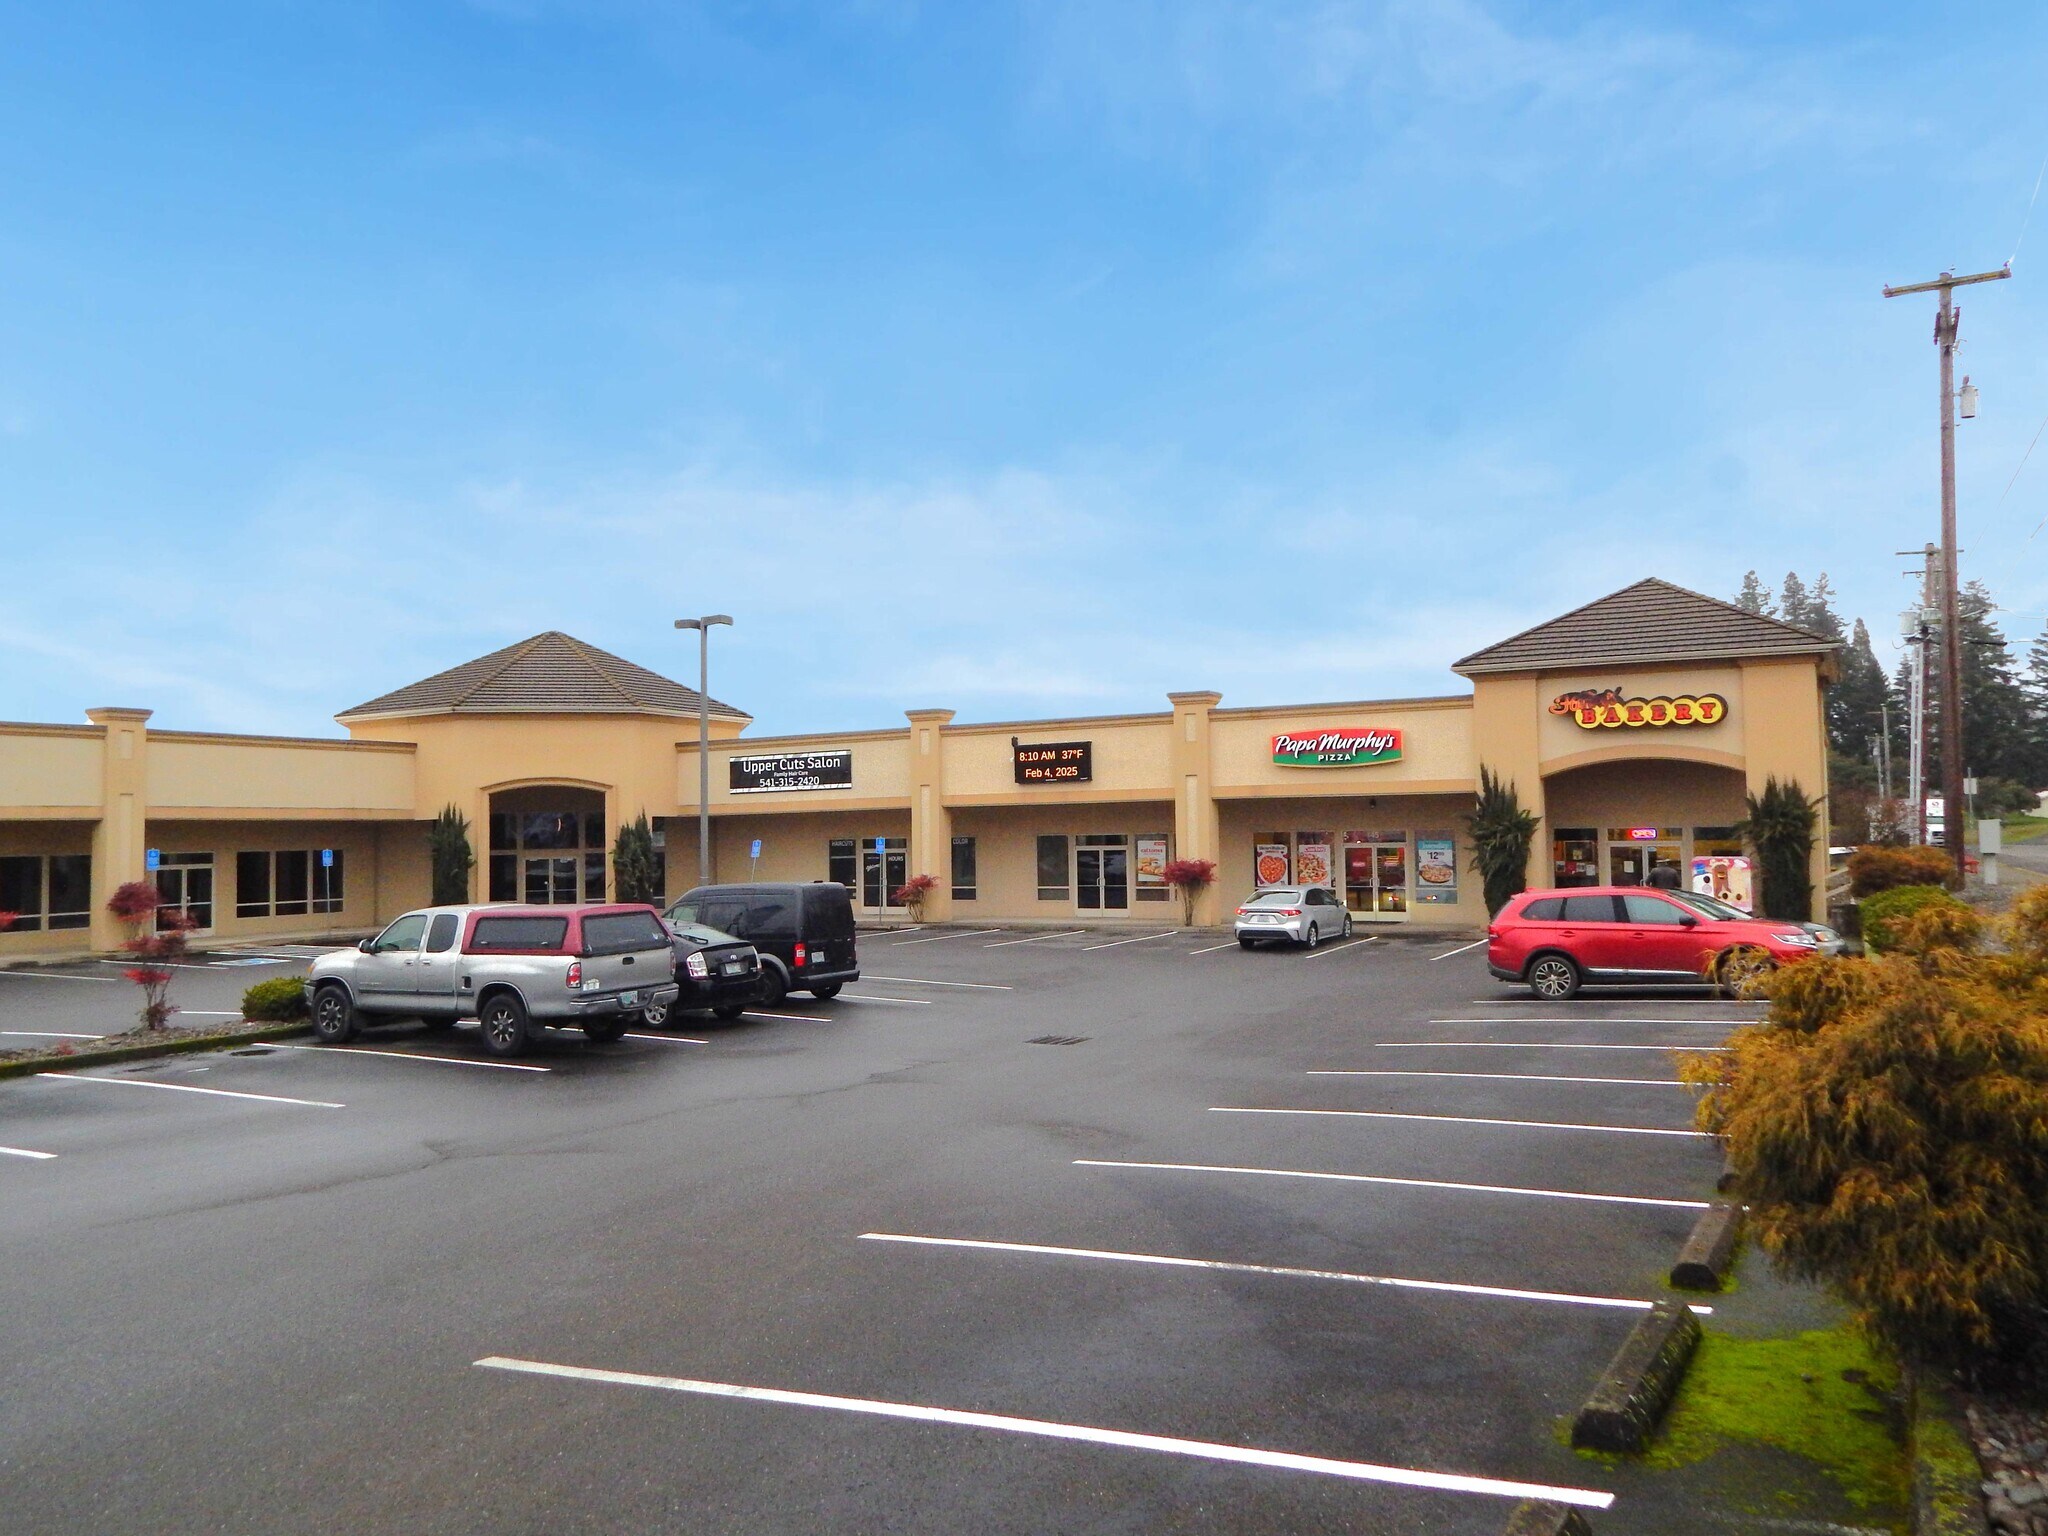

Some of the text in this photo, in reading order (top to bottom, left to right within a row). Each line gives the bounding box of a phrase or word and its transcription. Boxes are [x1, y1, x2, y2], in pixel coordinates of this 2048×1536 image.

[1581, 702, 1716, 724] BAKERY
[1275, 731, 1395, 758] Papa Murphy's
[1019, 749, 1083, 762] 8:10 AM 37°F
[1317, 753, 1351, 761] PIZZA
[743, 757, 840, 774] Upper Cuts Salon
[1025, 766, 1078, 778] Feb 4, 2025
[759, 776, 820, 788] 541-315-2420
[1631, 829, 1656, 838] OPEN
